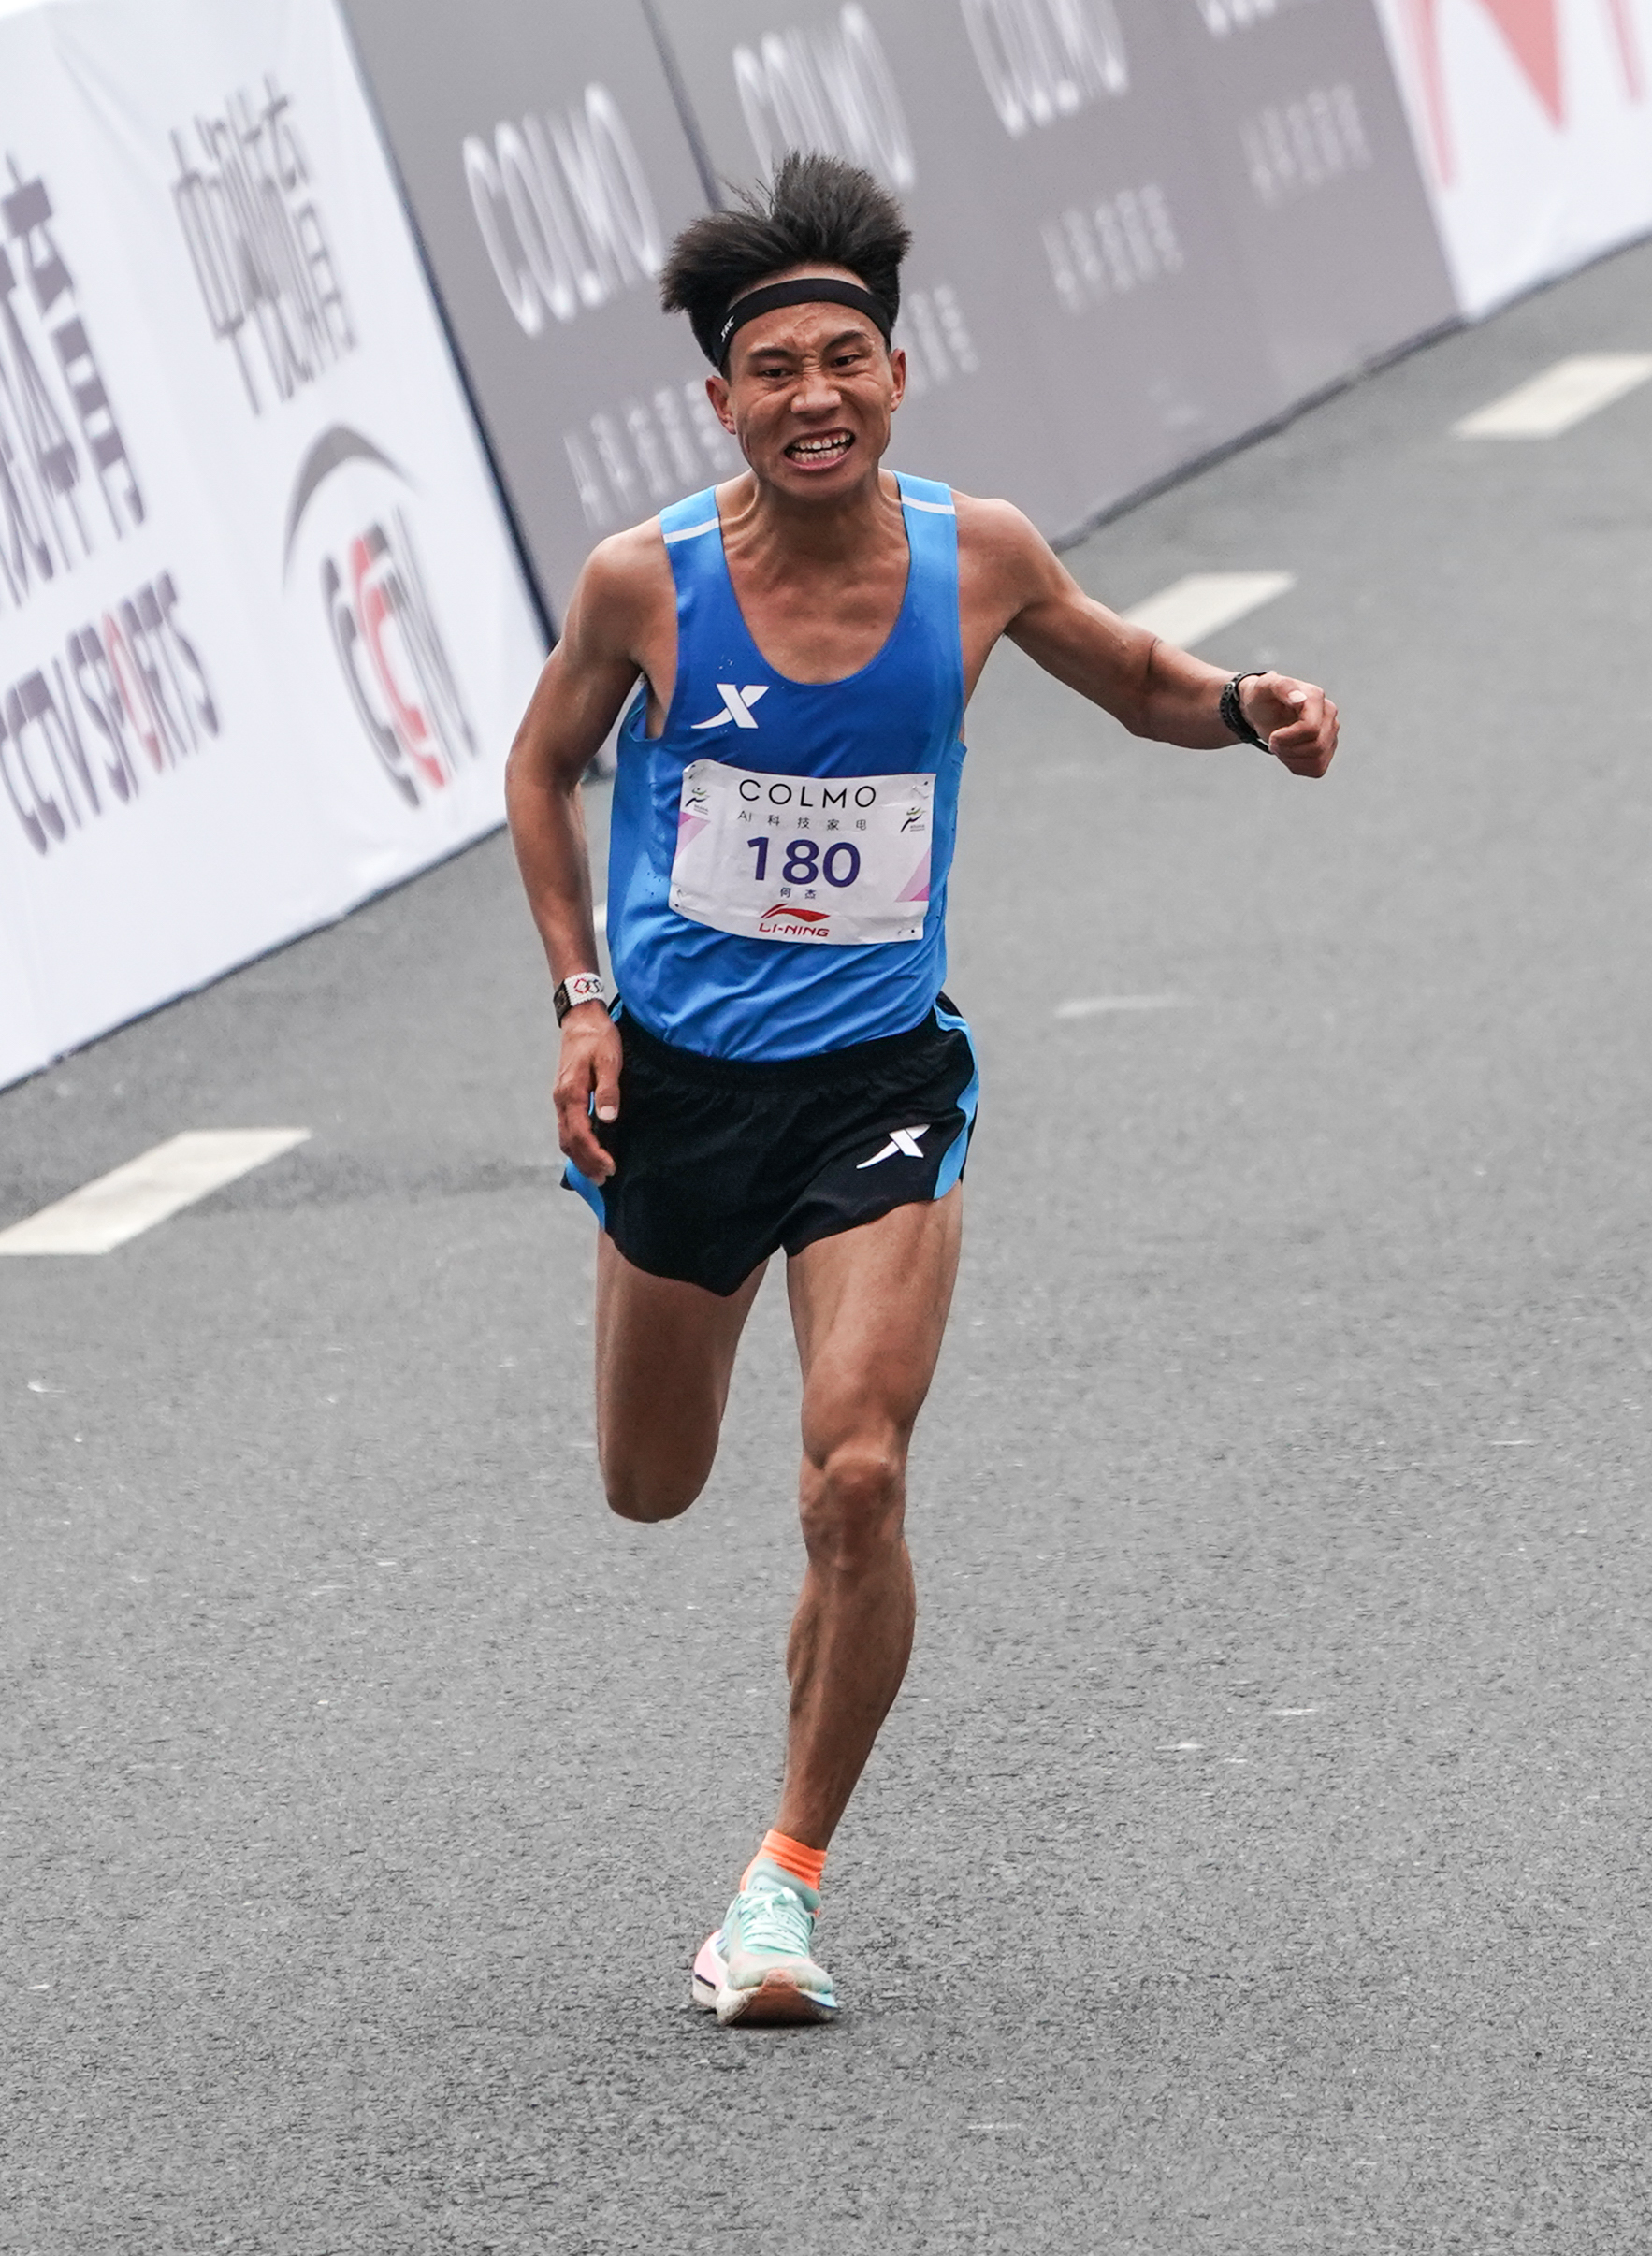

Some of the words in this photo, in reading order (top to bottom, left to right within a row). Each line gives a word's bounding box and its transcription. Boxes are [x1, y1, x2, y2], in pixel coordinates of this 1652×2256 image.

[462, 81, 662, 339] COLMO
[65, 568, 221, 807] SPORTS
[739, 778, 877, 809] COLMO
[746, 836, 861, 888] 180
[780, 887, 817, 899] 何杰
[759, 922, 831, 937] LI-NING
